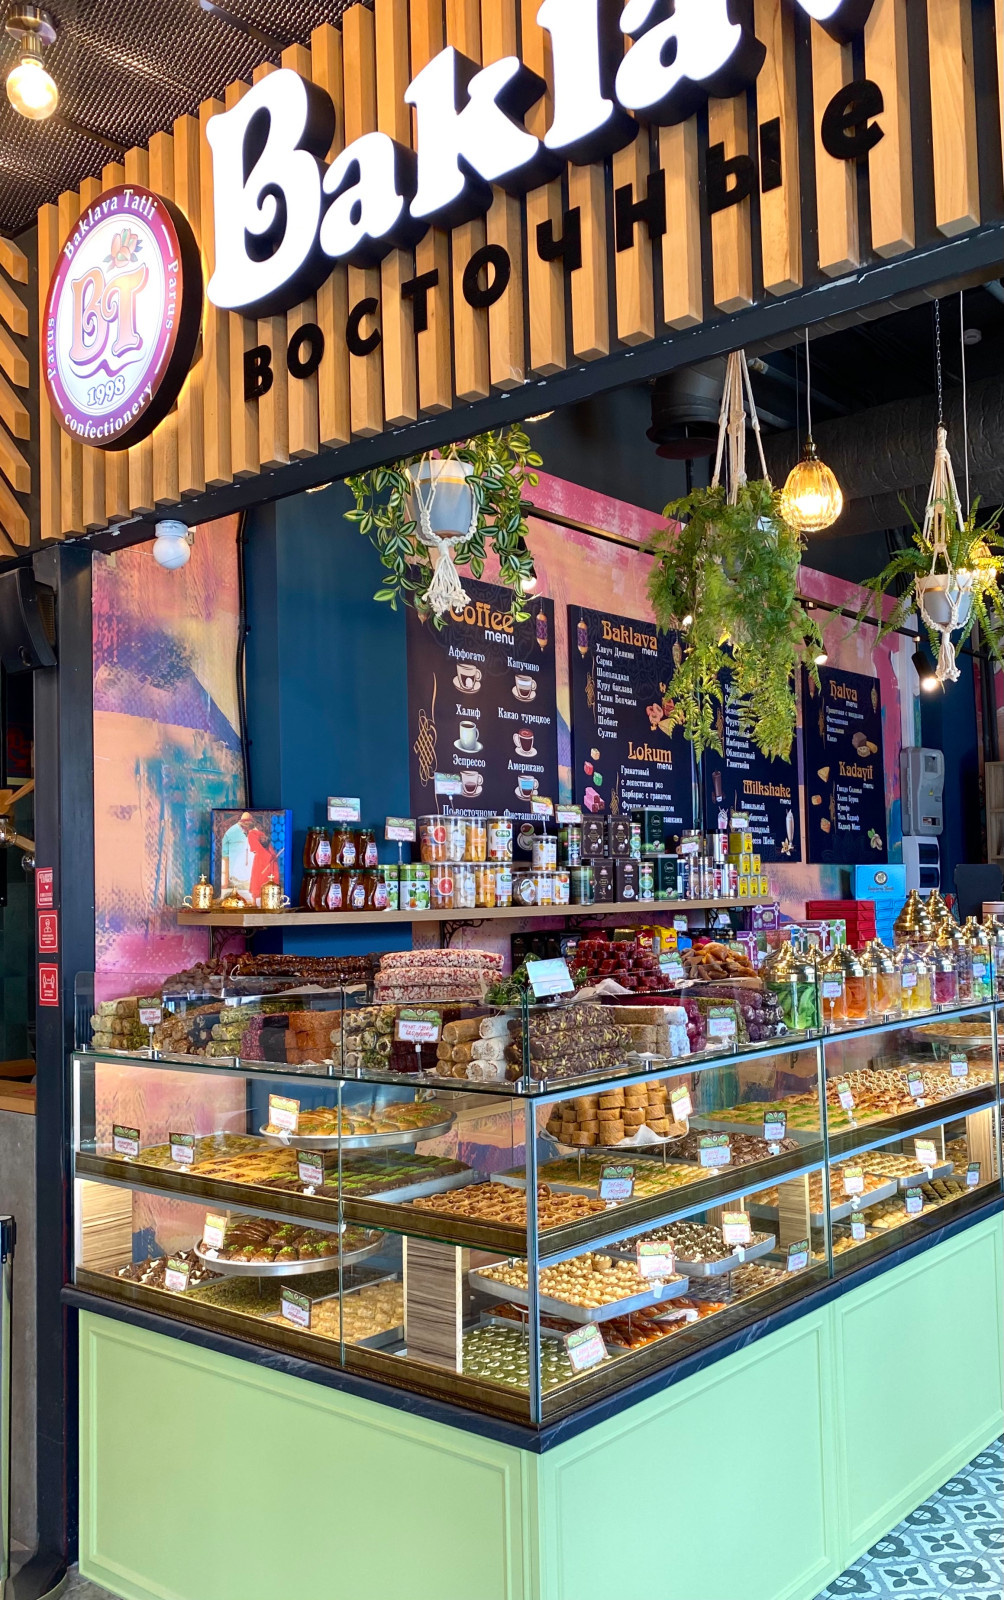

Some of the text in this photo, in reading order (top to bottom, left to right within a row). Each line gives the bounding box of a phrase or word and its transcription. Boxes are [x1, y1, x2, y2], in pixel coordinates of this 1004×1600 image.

[206, 0, 843, 310] Bakla
[63, 189, 158, 260] Baklava Tatli
[165, 259, 179, 330] Parus
[47, 317, 57, 381] Parus
[86, 375, 125, 406] 1998
[64, 380, 153, 440] confectionery
[485, 630, 514, 646] menu
[601, 620, 658, 650] Baklava
[448, 645, 486, 662] Аффогато
[641, 648, 658, 657] menu
[507, 656, 539, 672] Капучино
[595, 655, 613, 668] Сарма
[456, 704, 481, 719] Халиф
[498, 707, 551, 724] Какао турецкое
[597, 703, 615, 715] Бурма
[452, 753, 486, 768] Эспрессо
[627, 741, 673, 763] Lokum
[507, 759, 544, 773] Американо
[656, 762, 673, 771] menu
[743, 780, 791, 798] Milkshake
